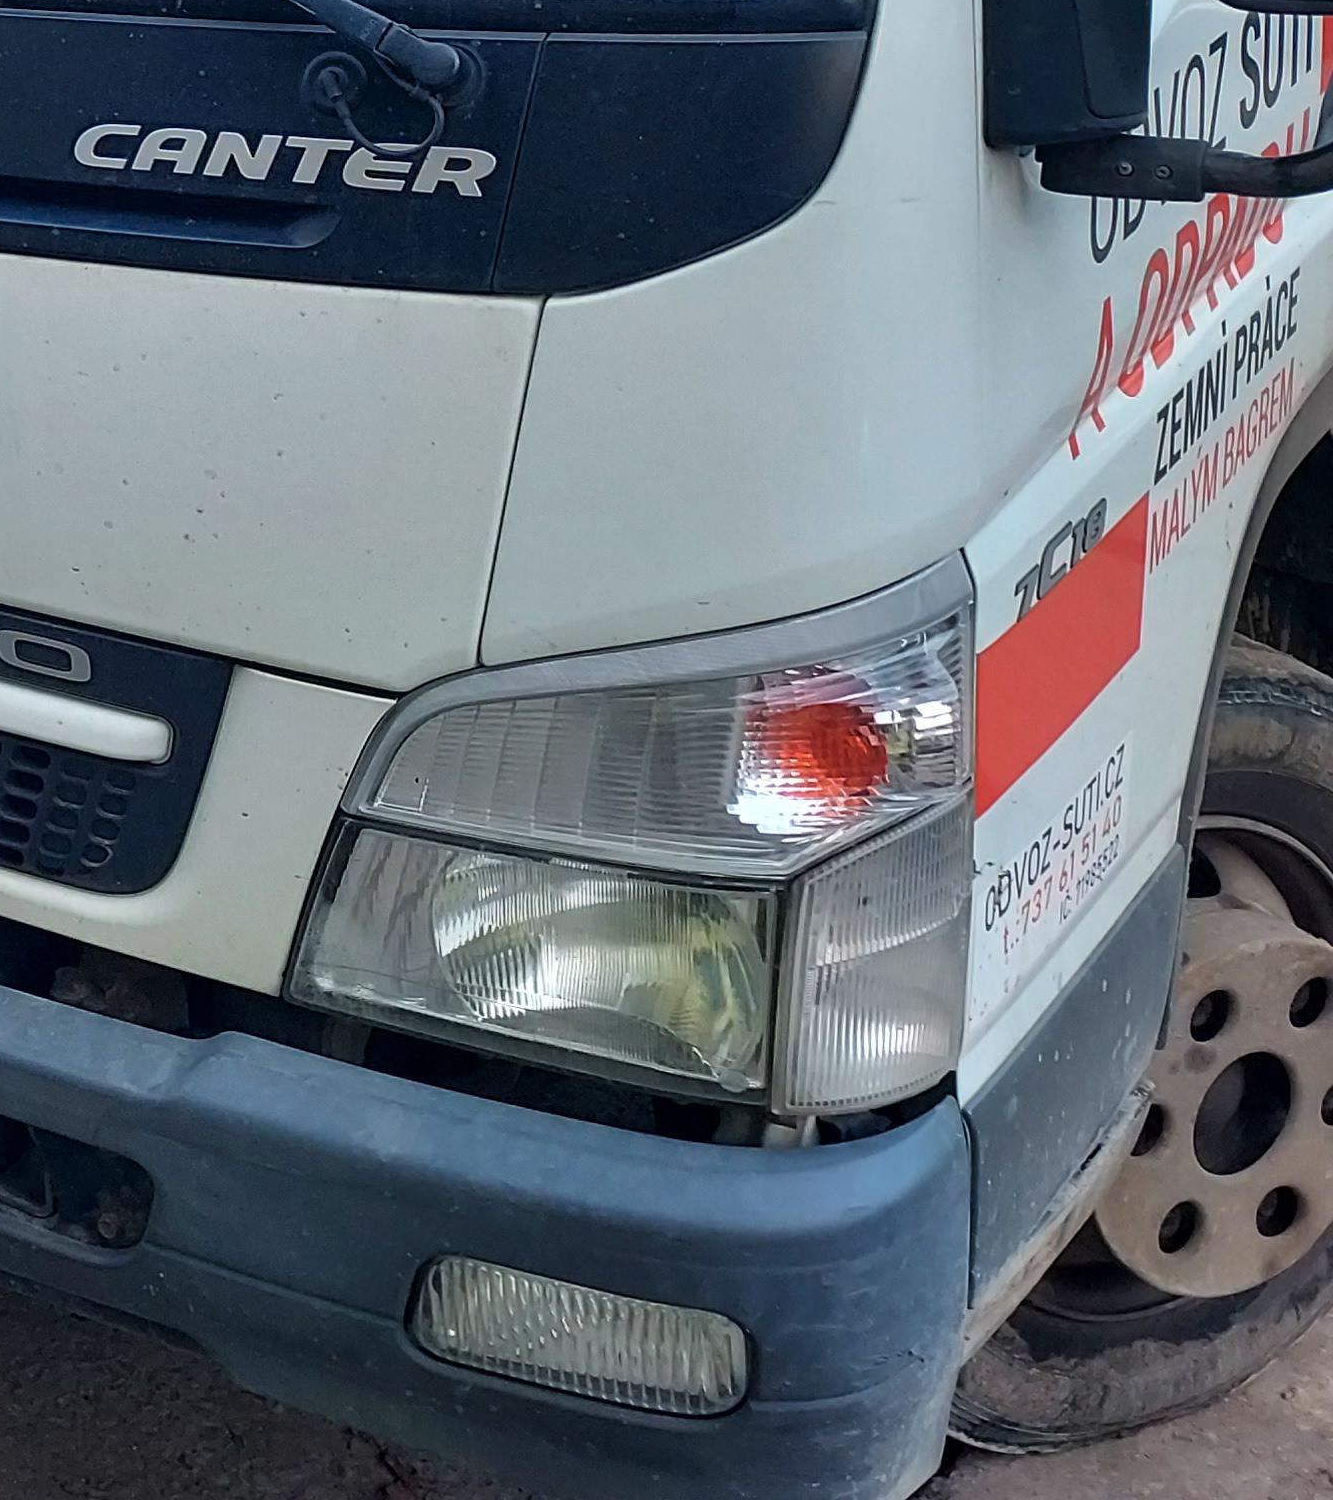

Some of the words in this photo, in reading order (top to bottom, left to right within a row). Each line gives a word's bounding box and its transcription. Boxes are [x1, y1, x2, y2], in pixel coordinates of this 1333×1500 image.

[74, 120, 496, 199] CANTER
[1068, 295, 1114, 461] A
[1152, 319, 1229, 487] ZEMNÍ
[1231, 266, 1301, 400] PRÁCE
[1148, 442, 1220, 576] MALÝM
[1222, 356, 1296, 490] BAGREM
[984, 743, 1125, 932] ODVOZ-SUTI.CZ
[1058, 849, 1075, 893] 61
[1081, 823, 1097, 866] 51
[1102, 794, 1123, 839] 40
